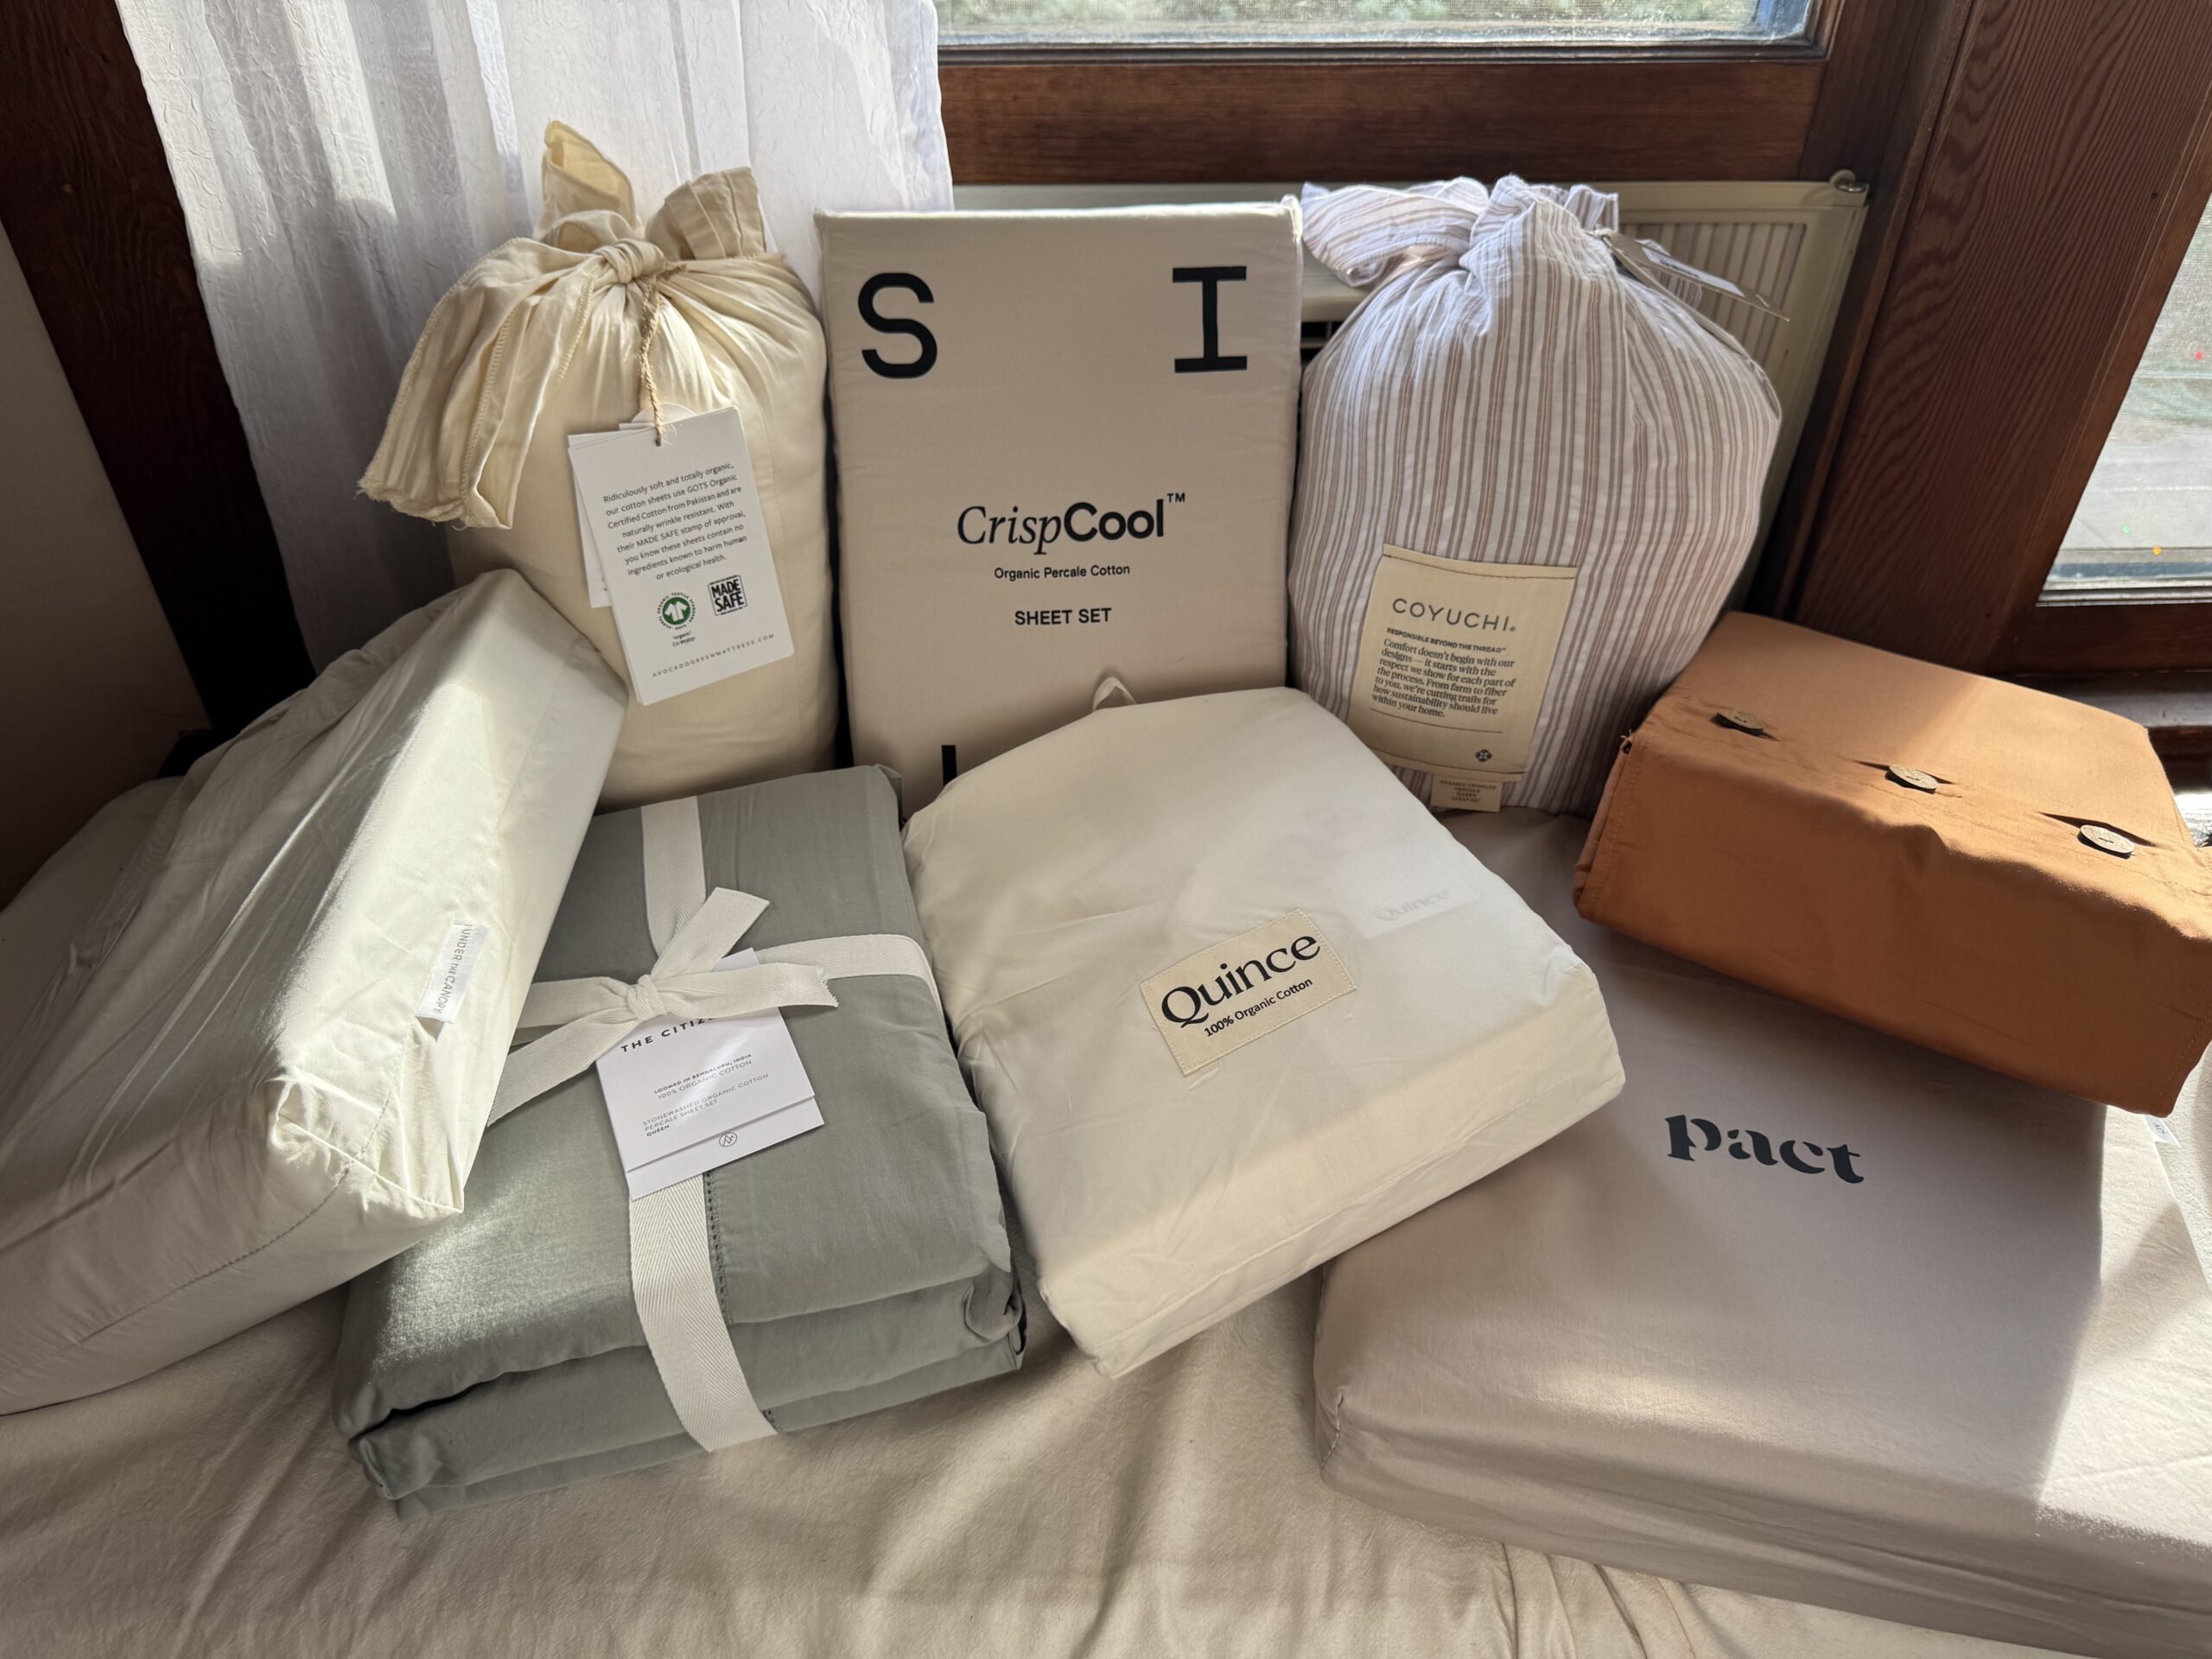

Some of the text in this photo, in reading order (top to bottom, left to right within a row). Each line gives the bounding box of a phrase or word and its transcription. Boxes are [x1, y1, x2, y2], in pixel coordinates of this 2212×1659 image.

[858, 266, 1247, 379] S I
[603, 463, 734, 503] Ridiculously soft and totally organic,
[622, 500, 646, 512] cotton
[648, 494, 671, 505] sheets
[688, 482, 709, 493] GOTS
[710, 475, 737, 488] Organic
[608, 515, 640, 529] Certified
[641, 508, 667, 519] Cotton
[668, 503, 686, 512] from
[686, 494, 715, 506] Pakistan
[717, 490, 729, 499] and
[622, 501, 734, 537] naturally wrinkle resistant. With
[617, 511, 746, 553] their MADE SAFE stamp of approval,
[625, 556, 639, 565] you
[640, 549, 660, 559] know
[662, 543, 681, 553] these
[683, 536, 706, 547] sheets
[707, 529, 734, 539] contain
[628, 560, 668, 575] ingredients
[669, 552, 693, 563] known
[703, 543, 722, 553] harm
[724, 536, 747, 546] human
[667, 562, 702, 576] ecological
[703, 555, 726, 566] health.
[711, 579, 741, 598] MADE
[994, 565, 1130, 582] Organic Percale Cotton
[715, 591, 745, 613] SAFE
[1014, 607, 1112, 626] SHEET SET
[1384, 639, 1421, 654] Comfort
[1450, 652, 1474, 666] begin
[1478, 657, 1497, 666] with
[1387, 627, 1429, 644] RESPONSIBLE
[1430, 638, 1458, 648] BEYOND
[652, 634, 774, 677] AVOCADOGREENMATTRESS.COM
[1382, 648, 1412, 663] designs
[1425, 658, 1433, 667] it
[1433, 661, 1457, 672] starts
[1459, 665, 1478, 676] with
[1480, 668, 1497, 677] the
[1377, 666, 1390, 677] the
[1391, 672, 1423, 684] process.
[1427, 678, 1449, 690] From
[1451, 683, 1472, 693] farm
[1484, 688, 1507, 697] fiber
[1379, 658, 1408, 671] respect
[1424, 669, 1446, 679] show
[1446, 673, 1460, 683] for
[1460, 676, 1482, 685] each
[1483, 677, 1504, 689] part
[1372, 694, 1445, 717] within your home.
[1374, 684, 1498, 715] how sustainability should live
[1384, 679, 1402, 690] you,
[1426, 690, 1457, 702] cutting
[1459, 695, 1481, 704] trails
[1483, 696, 1497, 706] for
[434, 929, 474, 1014] UNDER THE CANOPY
[1161, 937, 1320, 1028] Quince
[1205, 979, 1313, 1037] 100% Organic Cotton
[621, 1018, 713, 1052] THE CITIZ
[654, 1081, 682, 1094] LOOMED
[734, 1054, 752, 1063] INDIA
[658, 1060, 753, 1100] 100% ORGANIC COTTON
[643, 1073, 769, 1127] STONEWASHED ORGANIC COTTON
[645, 1099, 717, 1132] PERCALE SHEET SET
[646, 1124, 670, 1137] QUEEN
[1664, 1115, 1865, 1184] pact
